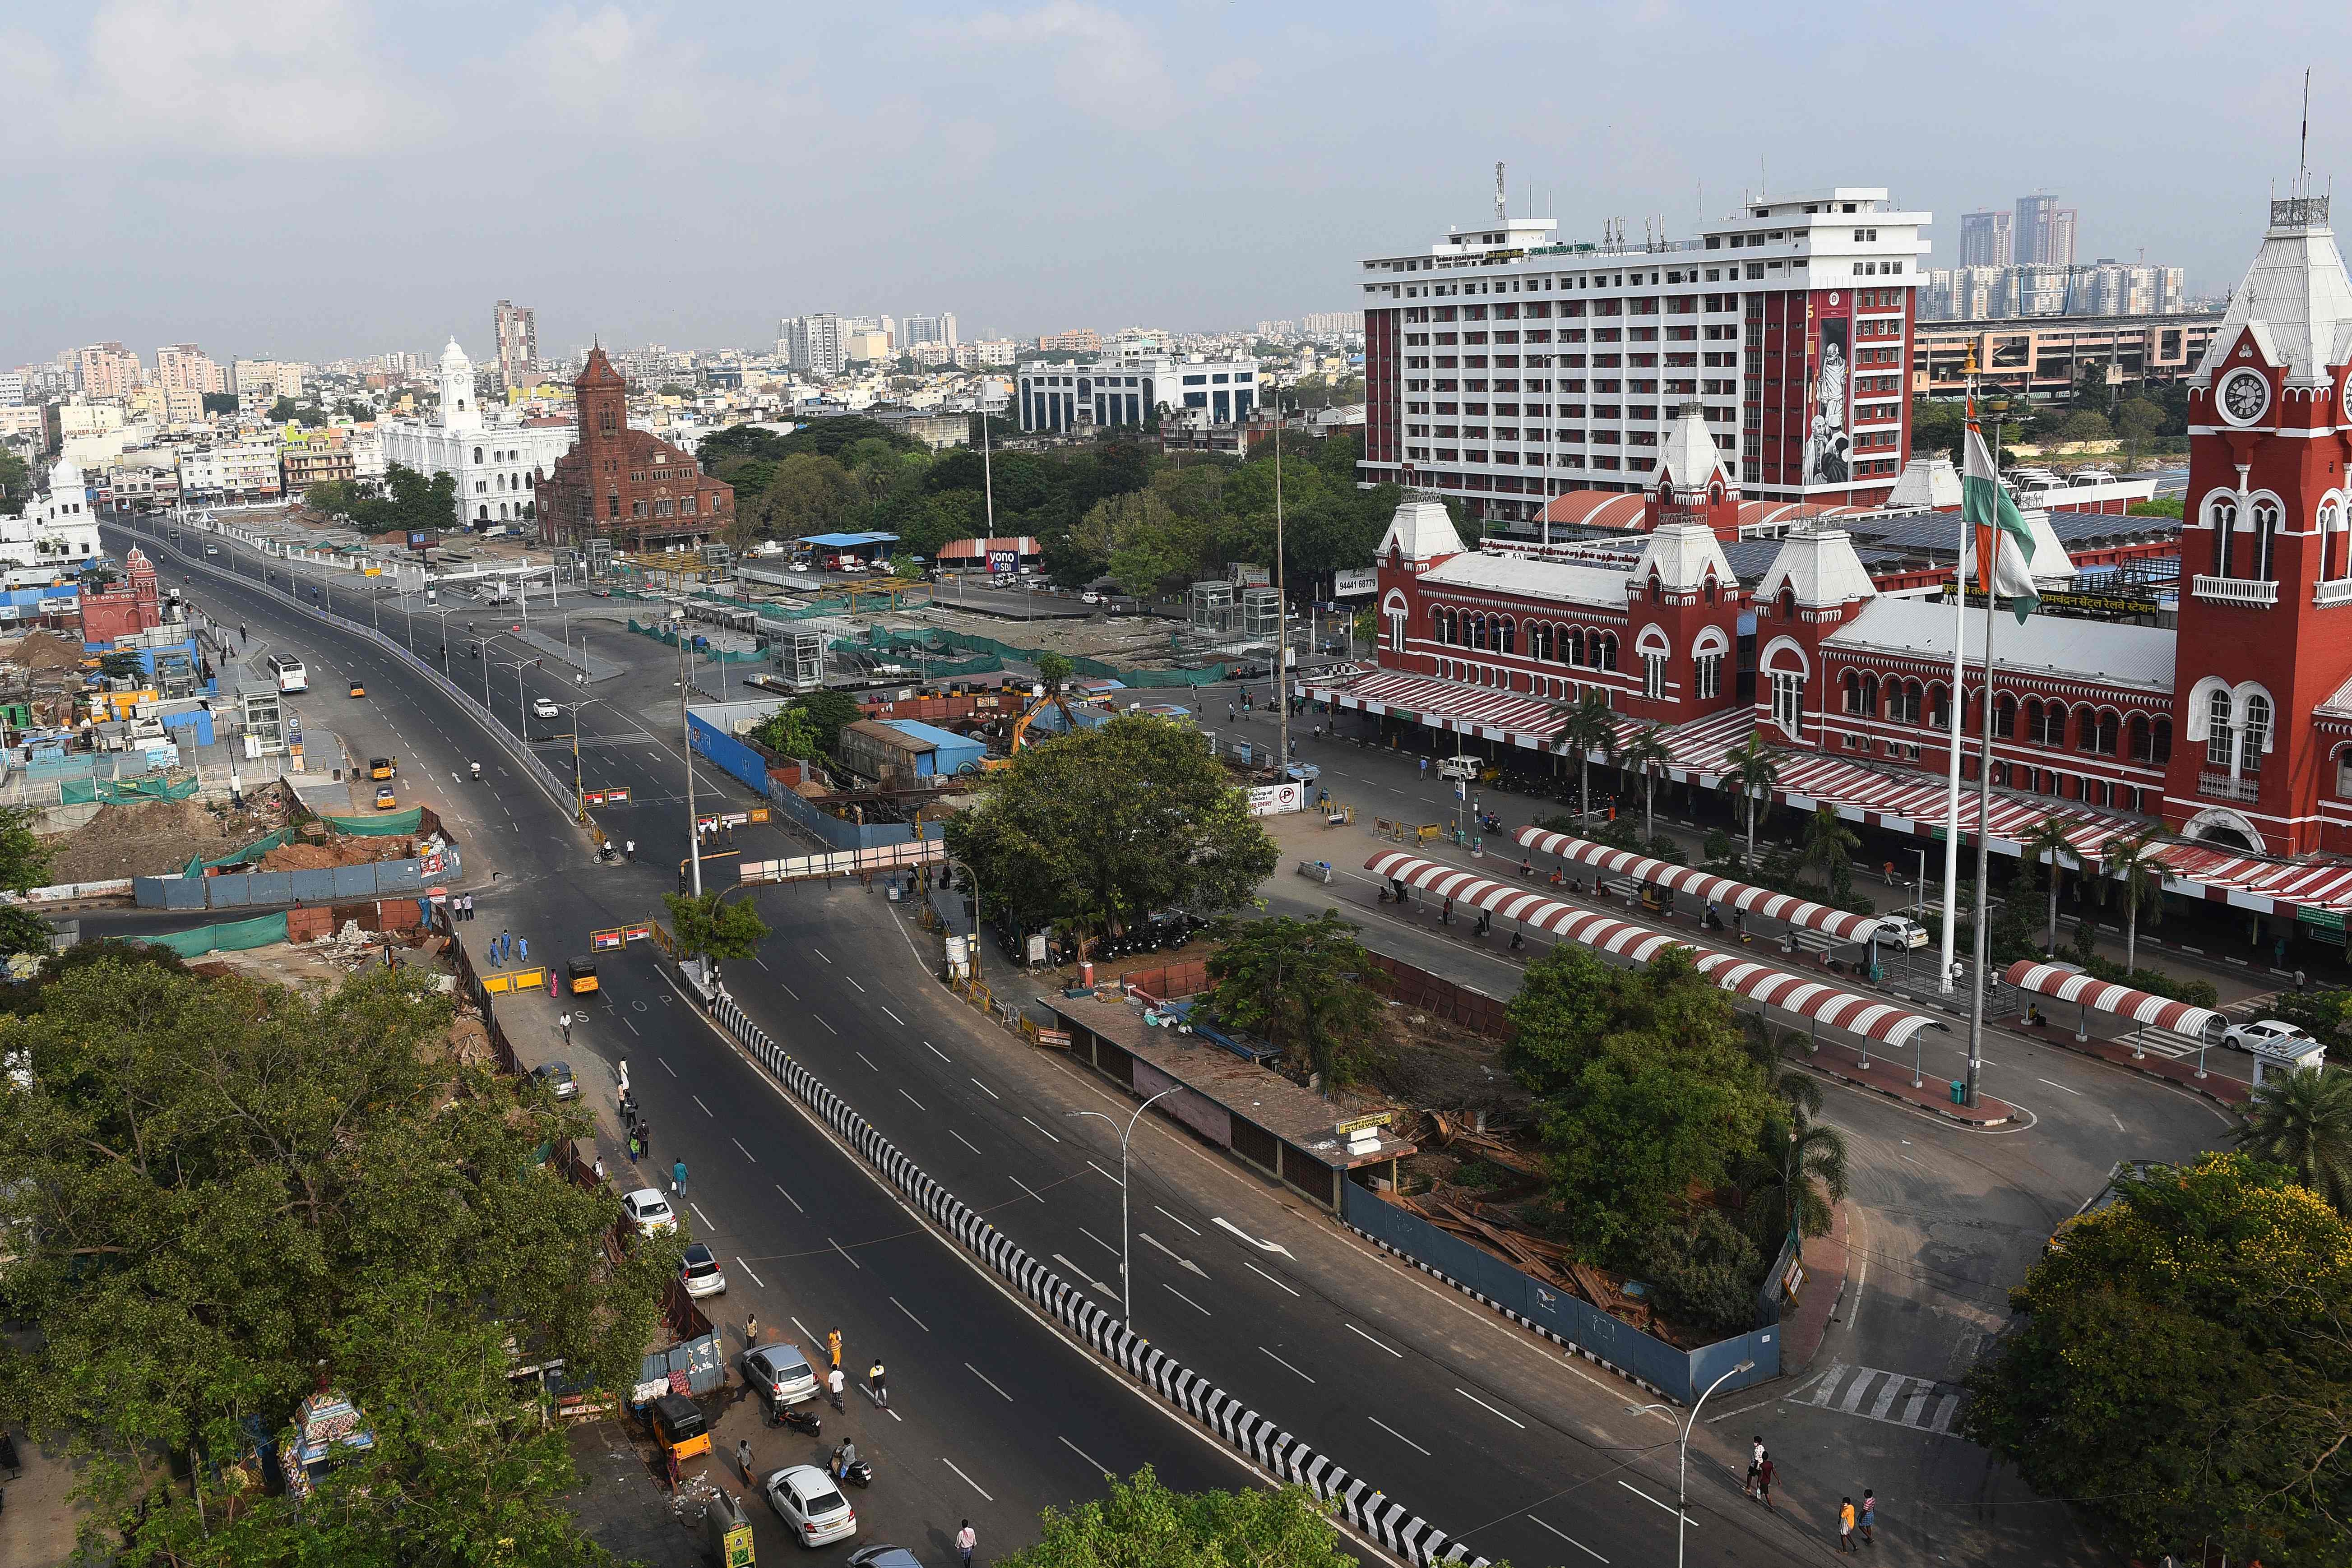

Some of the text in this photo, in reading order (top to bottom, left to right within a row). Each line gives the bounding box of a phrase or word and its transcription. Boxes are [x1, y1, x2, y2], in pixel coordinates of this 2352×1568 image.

[1528, 243, 1597, 256] CHENNAI SUBURBAN TERMINAL
[989, 552, 1014, 564] yono
[1000, 563, 1011, 572] SBI
[2040, 593, 2077, 606] रामचंद्रन
[2079, 595, 2102, 609] सेंट्रल
[2103, 598, 2125, 611] रेलवे
[2127, 601, 2157, 614] स्टेशन
[574, 995, 672, 1022] STOP
[1344, 1119, 1386, 1132] SUBWAY
[1362, 1115, 1387, 1124] DEPARTMENT
